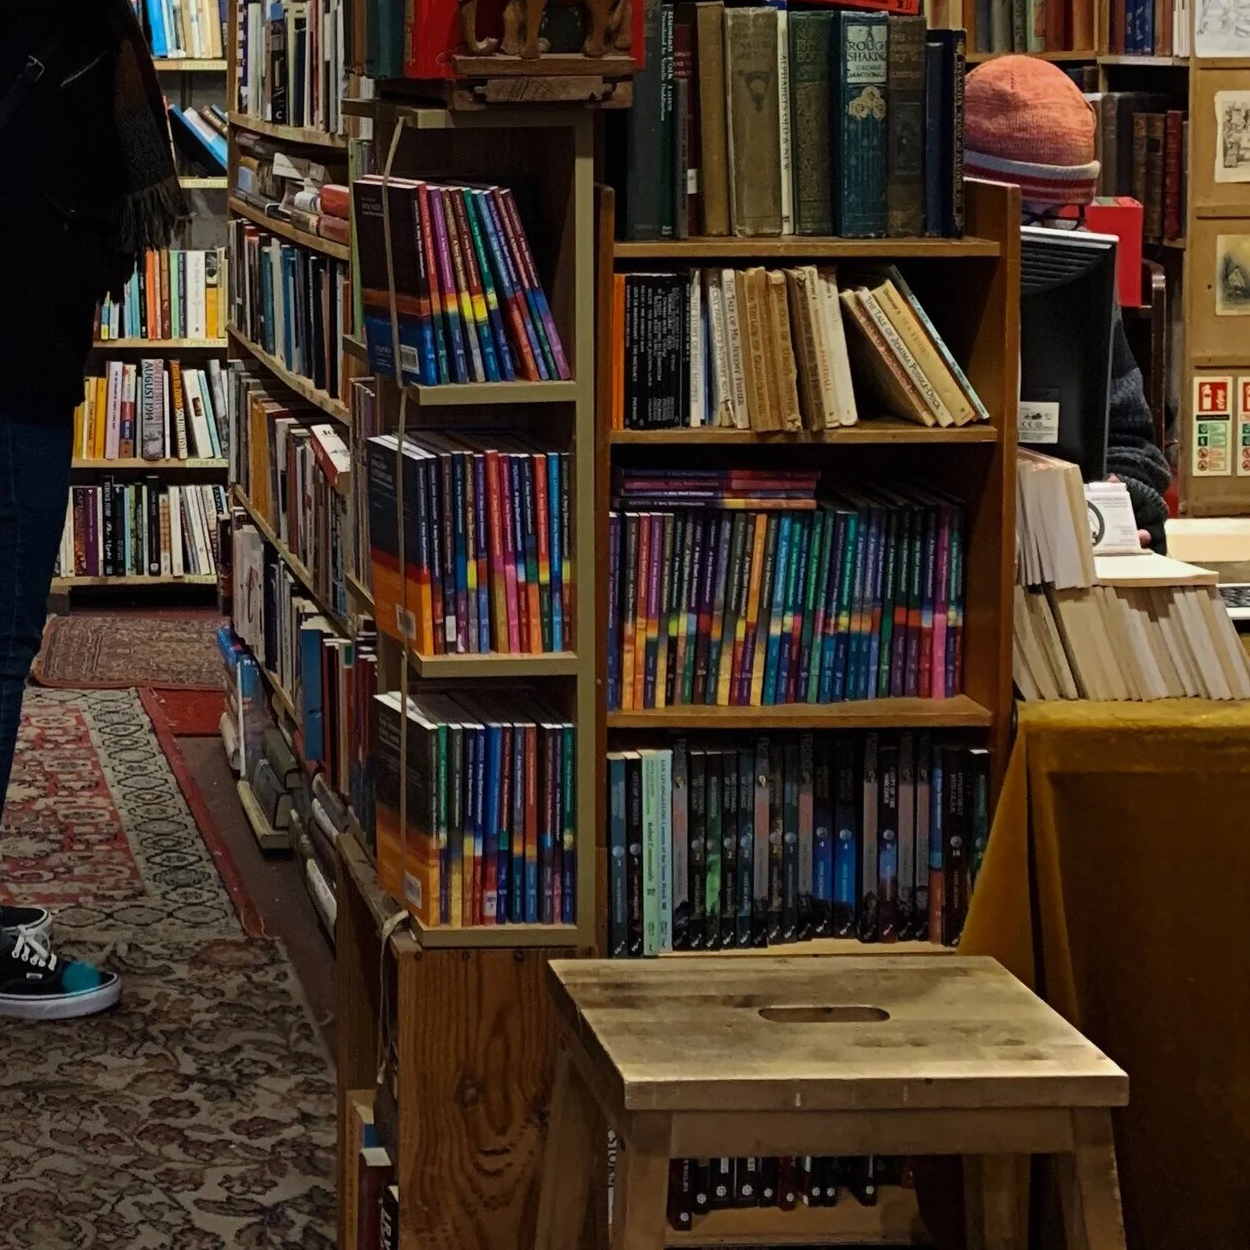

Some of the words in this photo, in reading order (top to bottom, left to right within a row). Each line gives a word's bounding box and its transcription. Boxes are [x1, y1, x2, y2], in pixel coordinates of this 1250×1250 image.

[732, 344, 742, 375] JEREMY
[865, 296, 875, 308] THE
[874, 310, 885, 326] TALE
[891, 337, 907, 363] JEMIMA
[910, 363, 941, 411] PUDDLE-DUCK
[736, 377, 745, 407] FISHER
